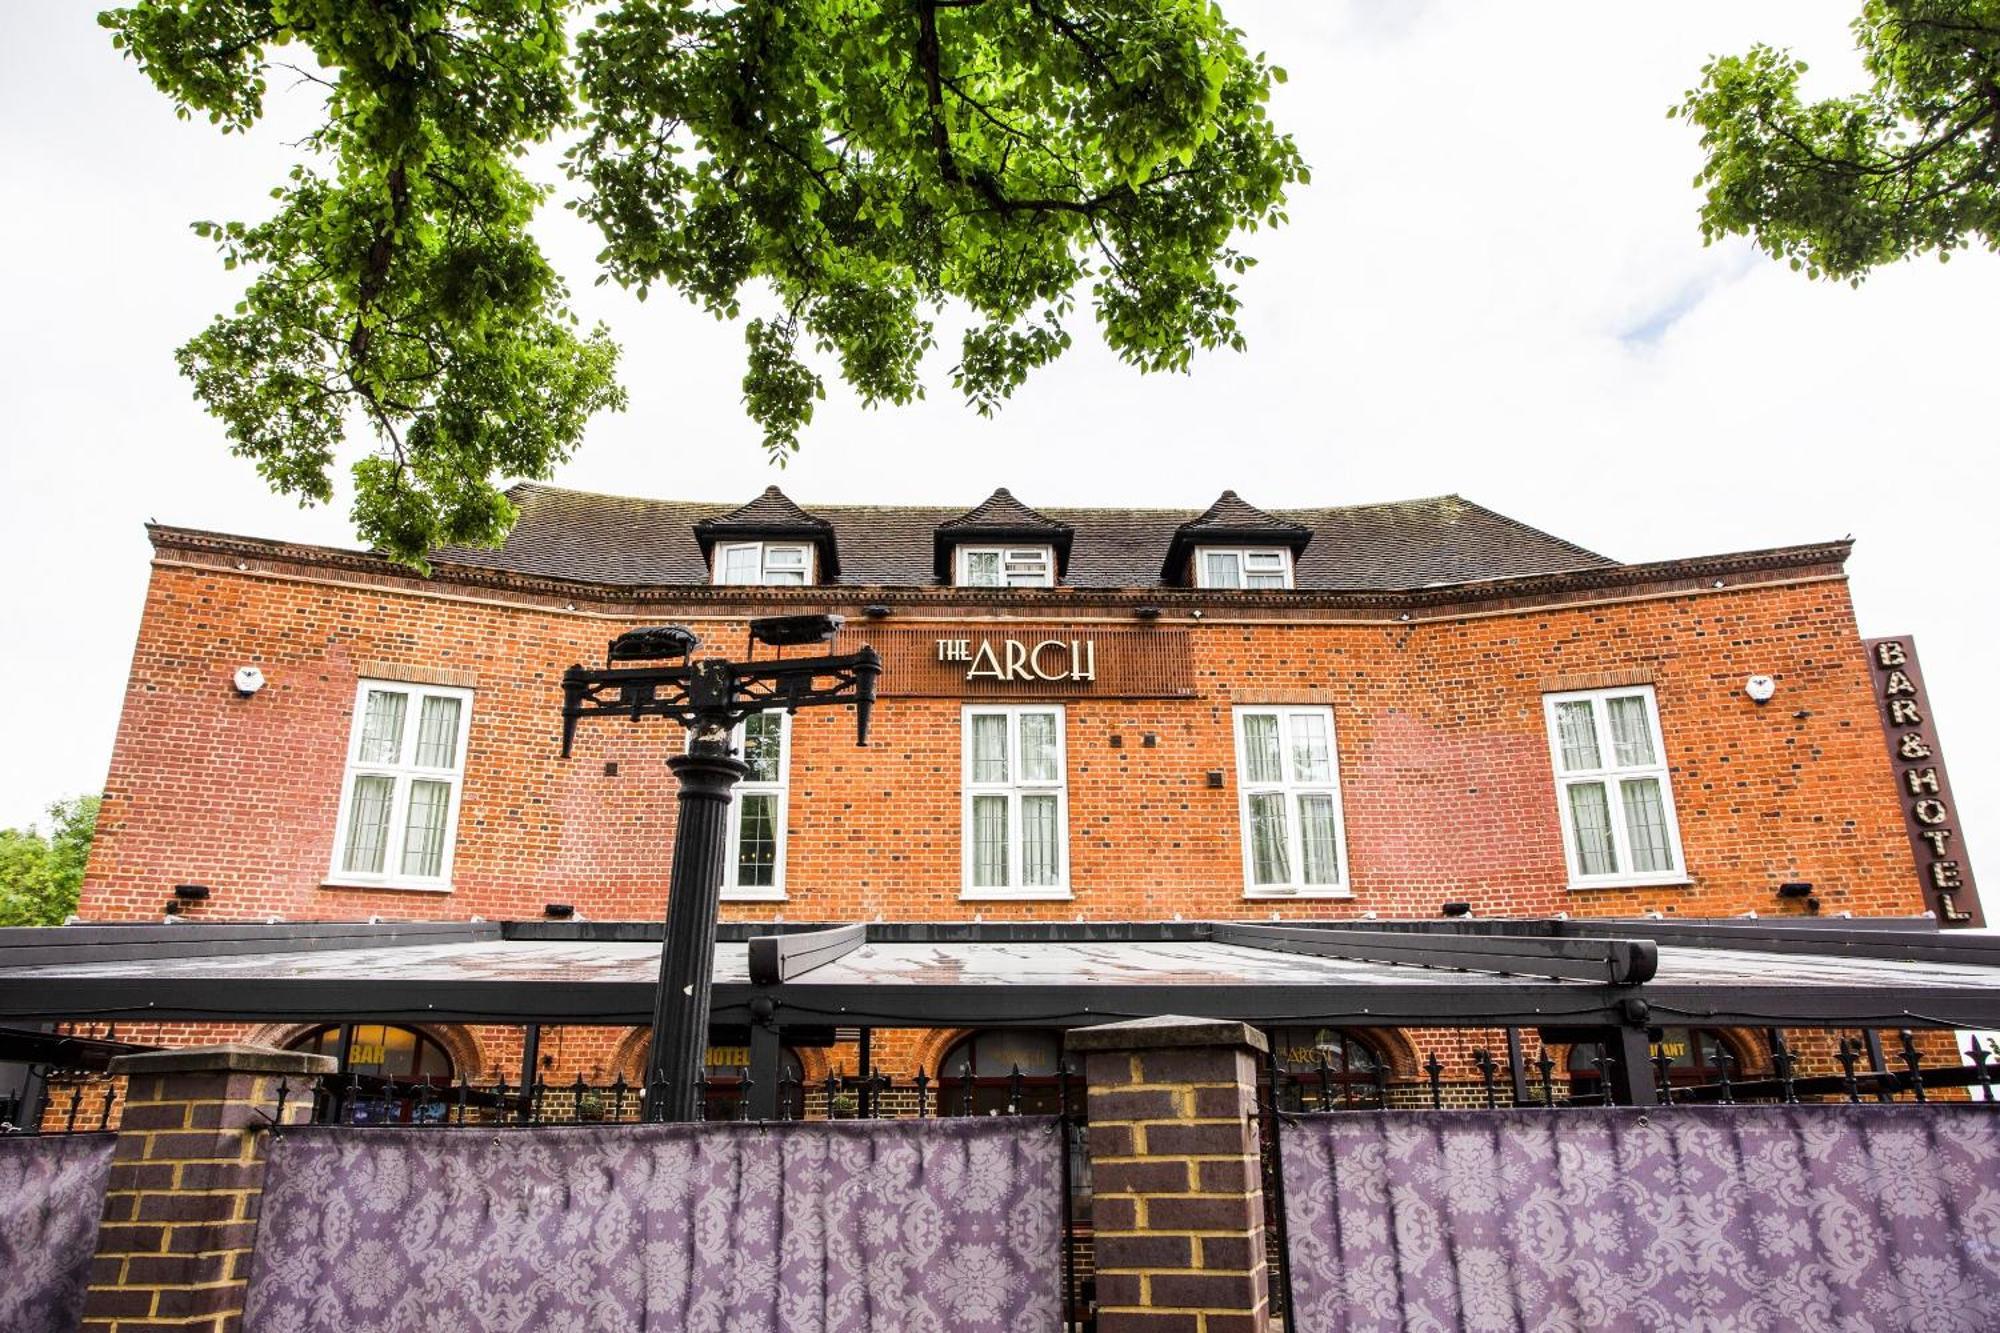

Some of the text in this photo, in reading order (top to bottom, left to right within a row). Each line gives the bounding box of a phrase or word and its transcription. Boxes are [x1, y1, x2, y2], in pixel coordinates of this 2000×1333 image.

[936, 638, 1095, 681] THE ARCH
[1876, 640, 1971, 922] BAR & HOTEL
[348, 1044, 384, 1065] BAR
[704, 1046, 751, 1067] HOTEL
